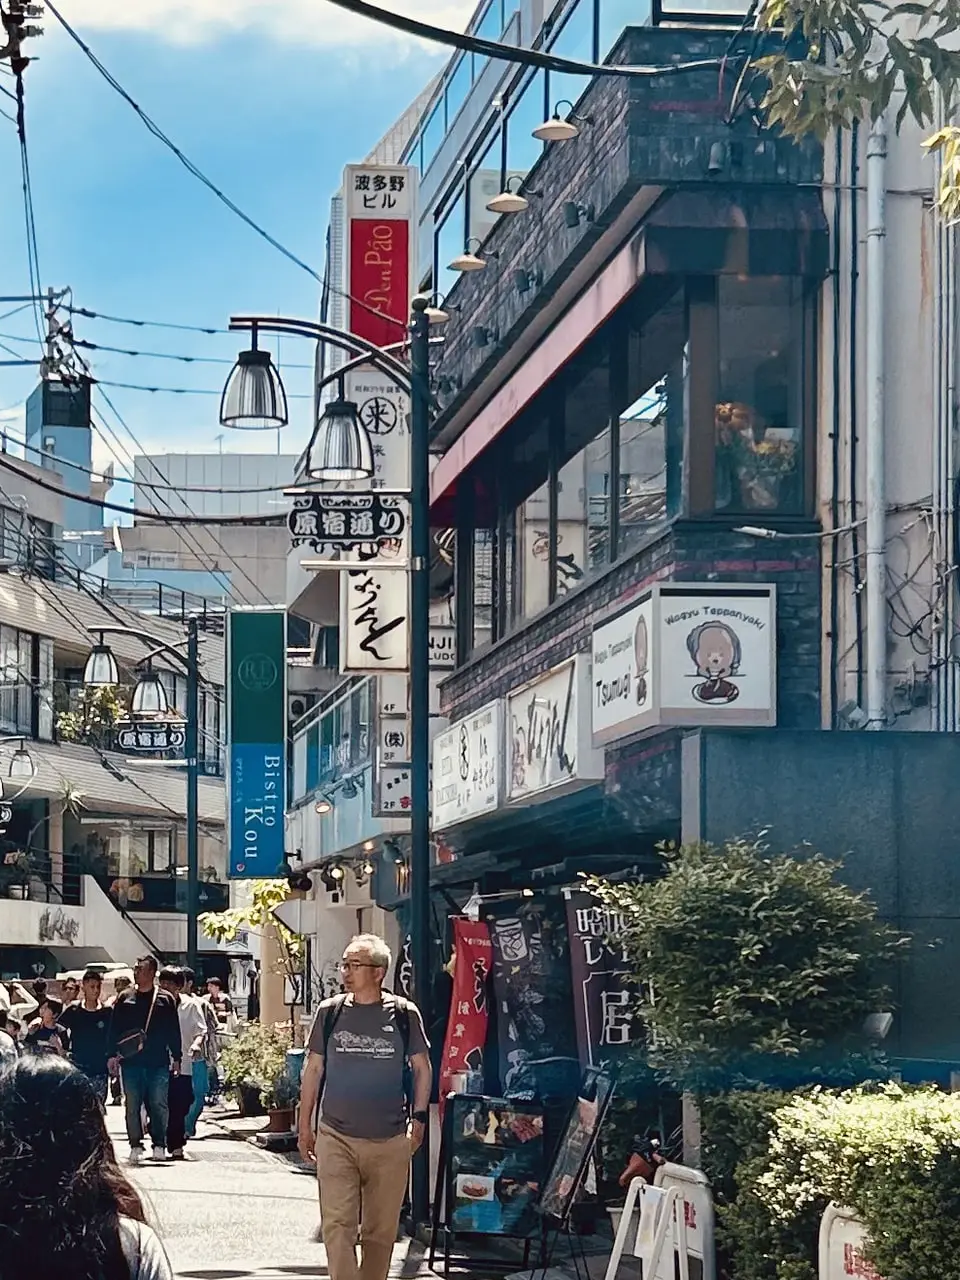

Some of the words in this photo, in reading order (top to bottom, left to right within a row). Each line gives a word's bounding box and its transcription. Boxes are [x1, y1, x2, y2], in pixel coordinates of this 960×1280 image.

[354, 174, 405, 192] 波多野
[363, 195, 397, 209] ビル
[293, 511, 401, 536] 原宿通り
[664, 610, 700, 627] Wagyu
[702, 605, 766, 632] Teppanyaki
[595, 663, 632, 707] Tsumugi
[383, 703, 396, 712] 4F
[122, 731, 185, 748] 原宿通り
[384, 731, 405, 748] (株)
[264, 754, 281, 828] Bistro
[383, 801, 395, 810] 2F
[244, 806, 264, 859] Kou
